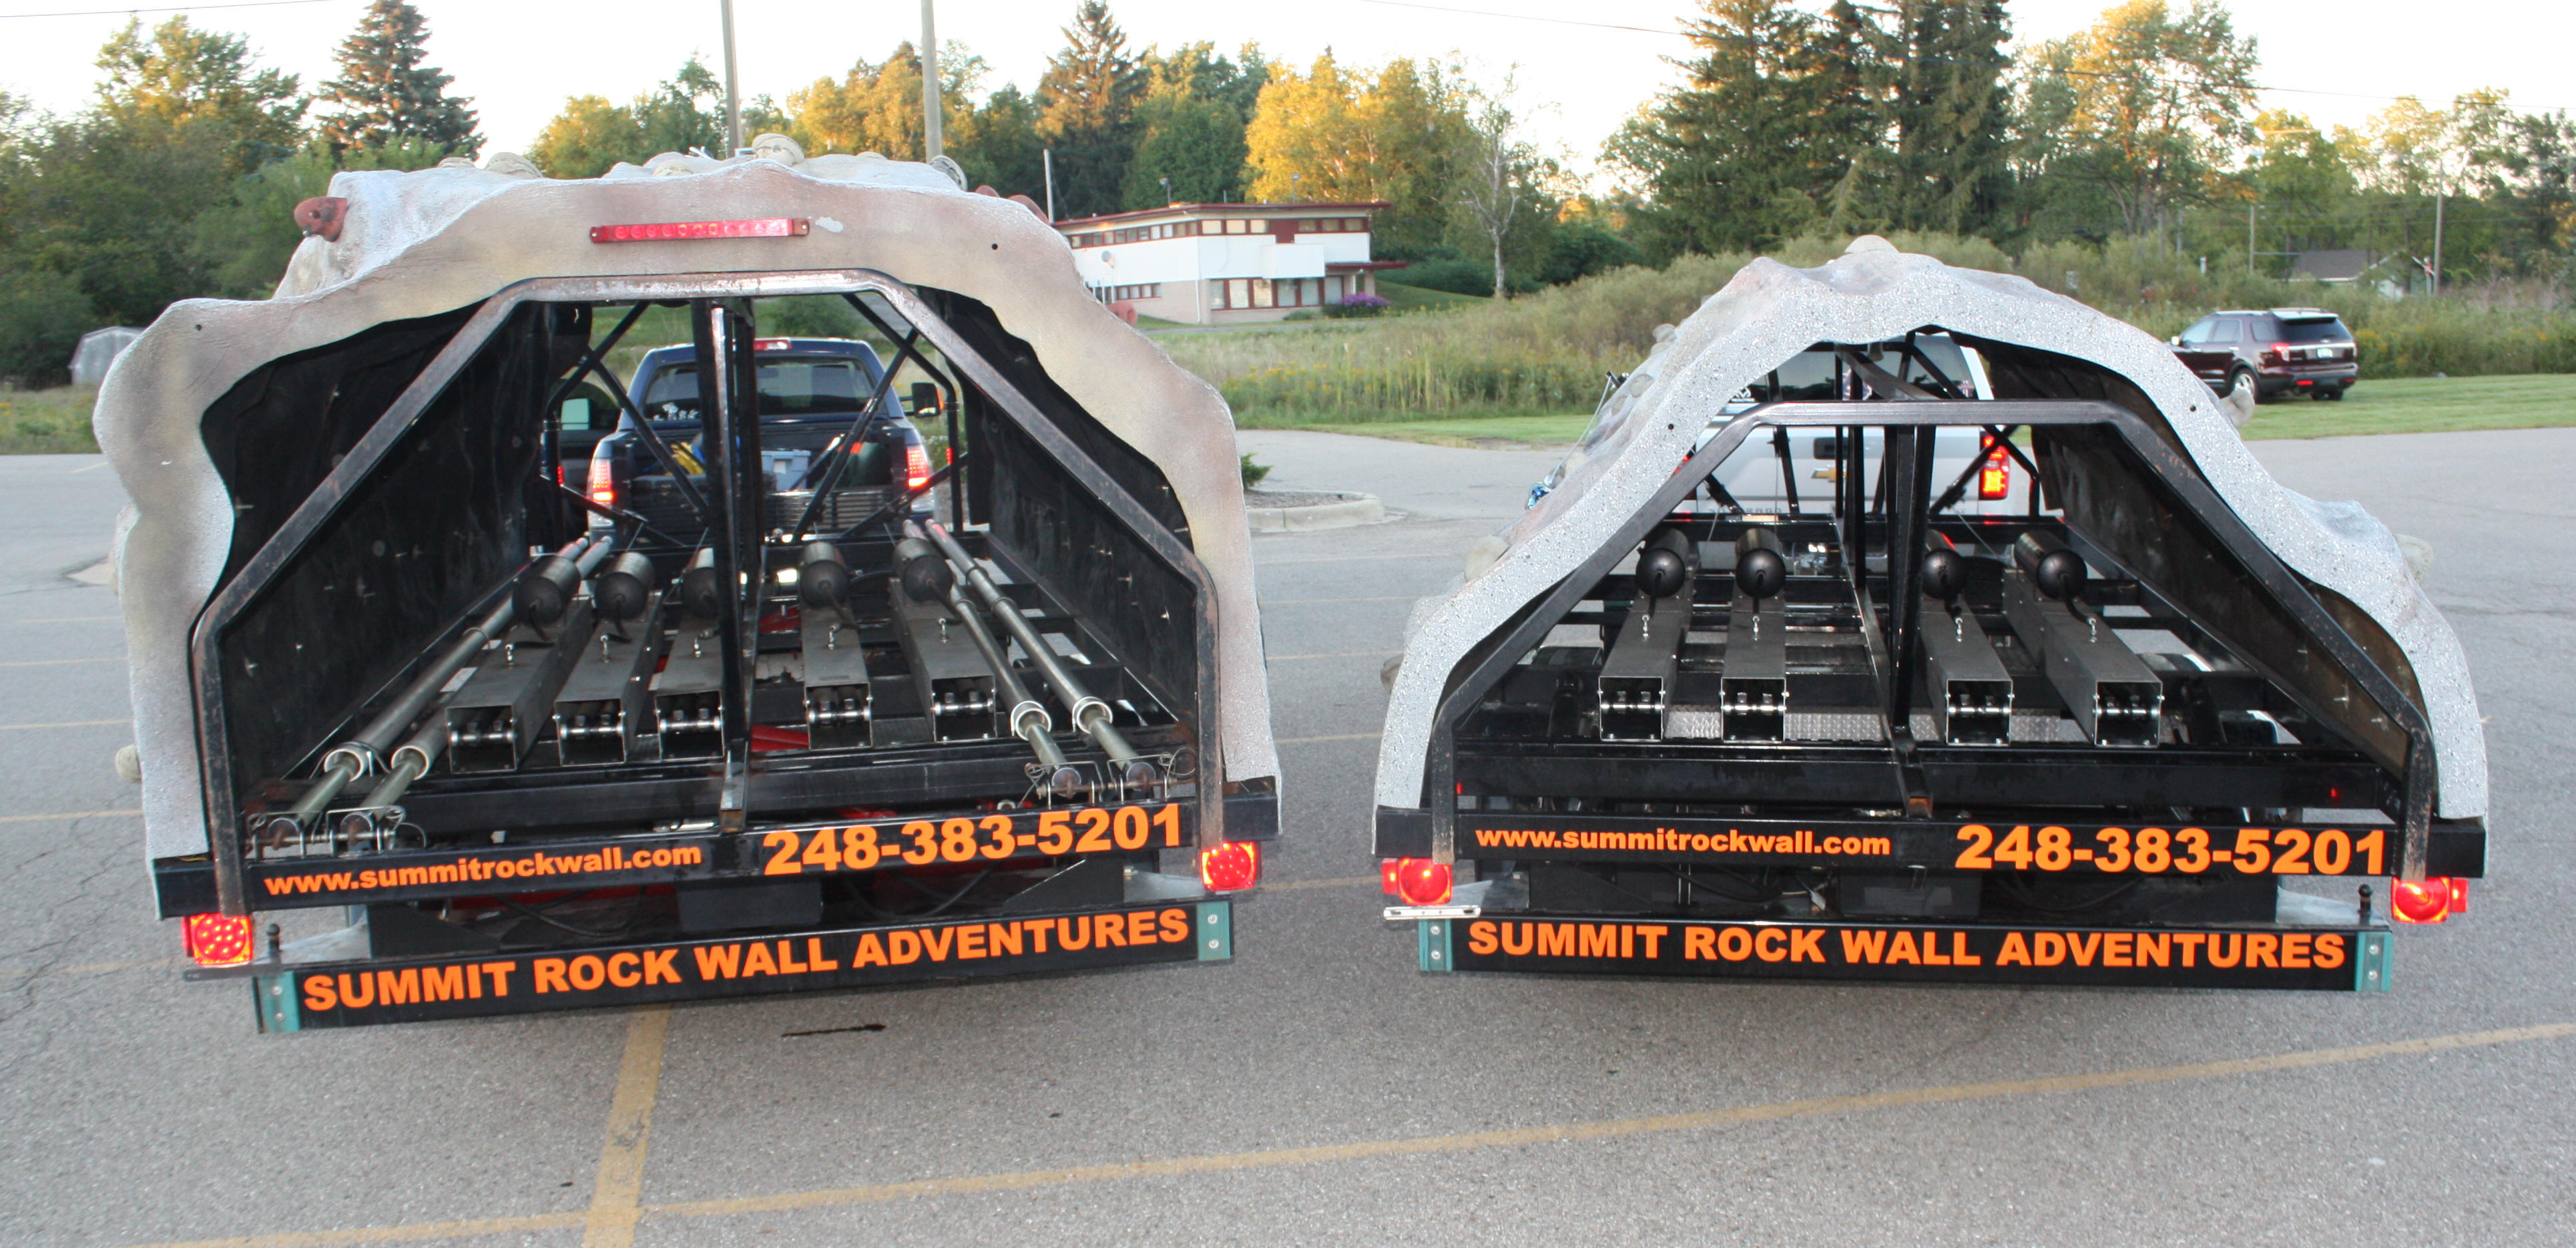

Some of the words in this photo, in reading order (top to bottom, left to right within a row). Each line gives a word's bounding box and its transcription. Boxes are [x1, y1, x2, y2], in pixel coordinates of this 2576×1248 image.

[762, 804, 1180, 875] 248-383-5201
[1475, 827, 1891, 855] www.summitrockwall.com
[1955, 824, 2384, 875] 248-383-5201
[264, 846, 702, 895] www.summitrockwall.com
[304, 961, 516, 1011] SUMMIT
[533, 949, 682, 994] ROCK
[694, 938, 838, 980] WALL
[852, 908, 1189, 968] ADVENTURES
[1469, 921, 1667, 958] SUMMIT
[1685, 926, 1826, 962] ROCK
[1840, 929, 1981, 966] WALL
[1996, 932, 2345, 968] ADVENTURES
